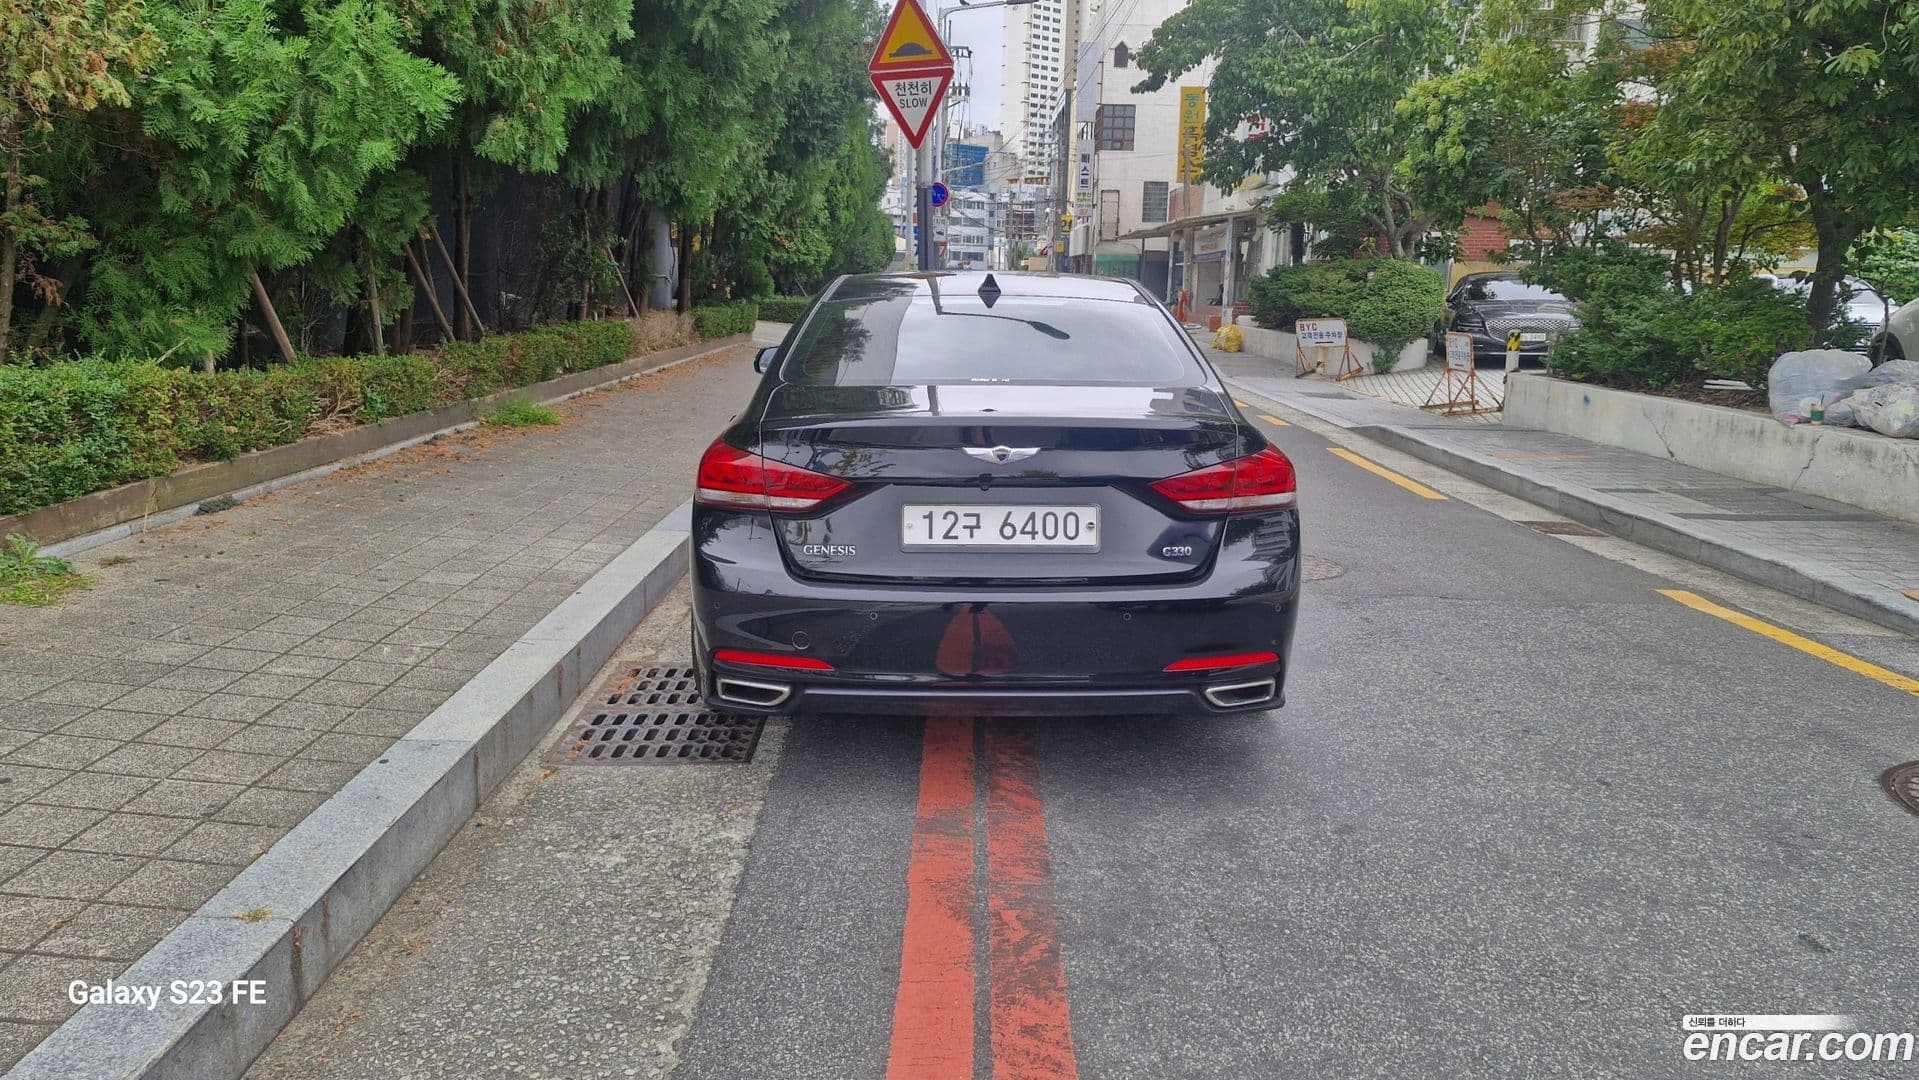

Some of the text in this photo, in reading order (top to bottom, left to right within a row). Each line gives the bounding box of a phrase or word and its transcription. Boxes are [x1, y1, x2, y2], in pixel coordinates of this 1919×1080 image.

[895, 80, 932, 96] 천천히
[899, 98, 928, 108] SLOW
[1080, 153, 1090, 188] 베스트
[1299, 323, 1317, 331] BYC
[922, 510, 1080, 541] 12구 6400
[803, 544, 856, 556] GENESIS
[1162, 545, 1192, 557] G330
